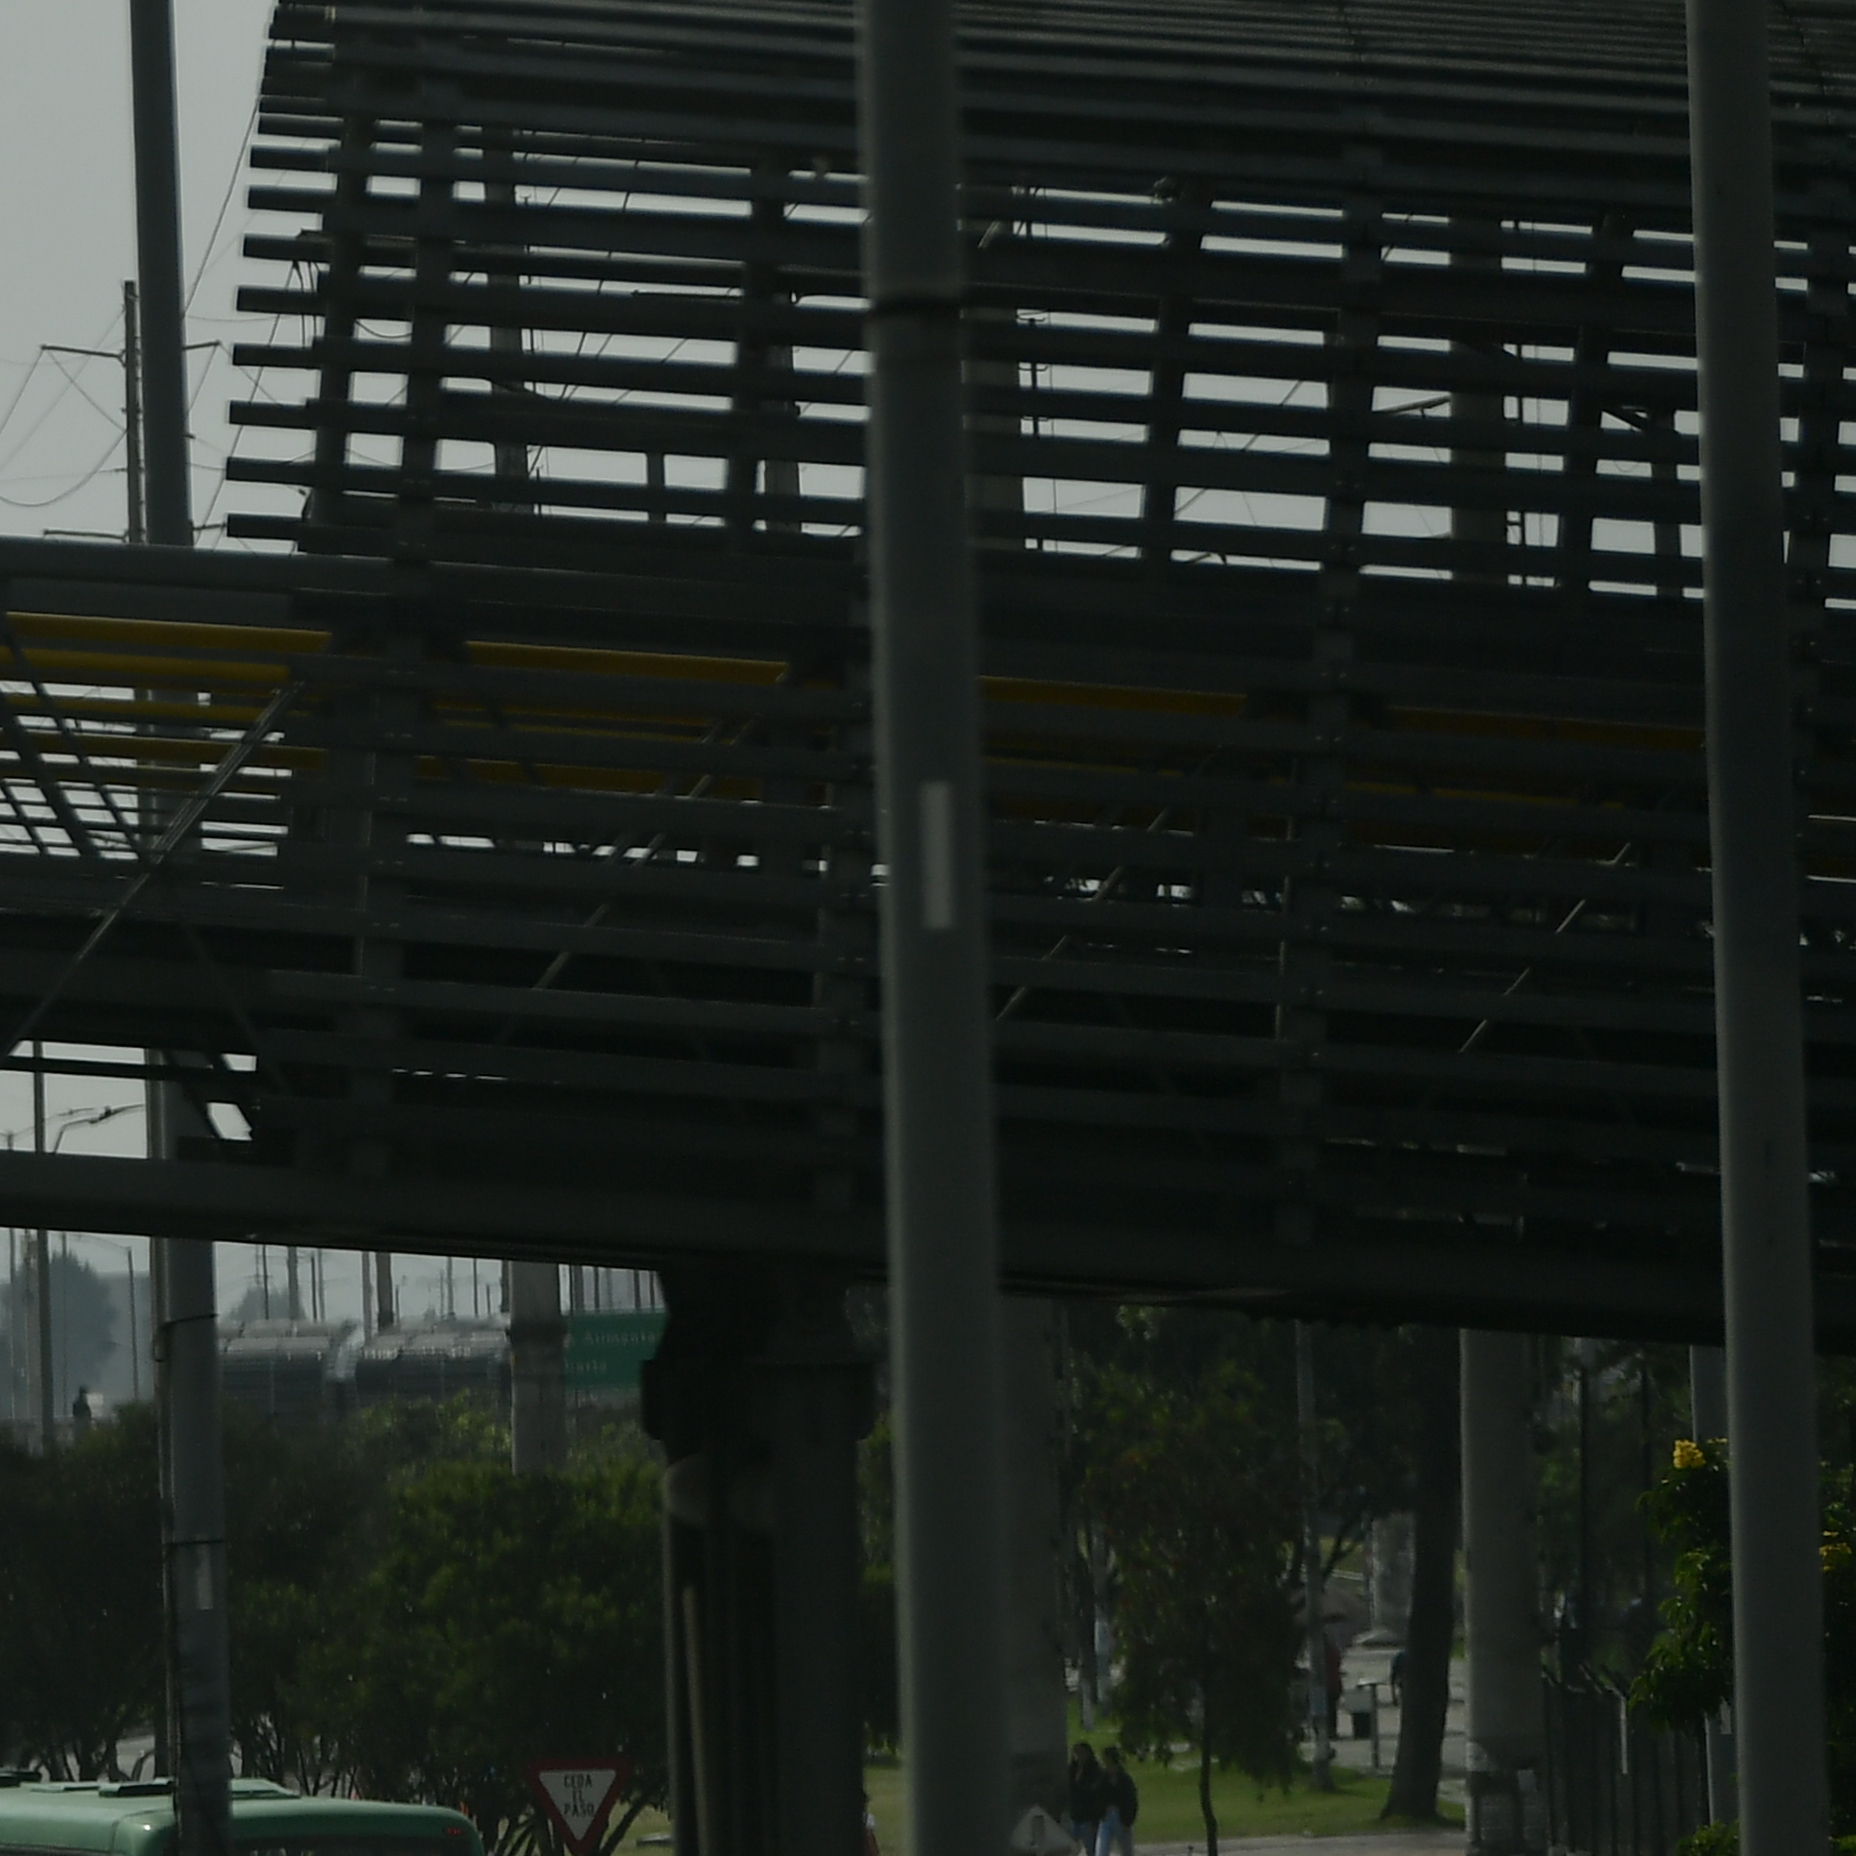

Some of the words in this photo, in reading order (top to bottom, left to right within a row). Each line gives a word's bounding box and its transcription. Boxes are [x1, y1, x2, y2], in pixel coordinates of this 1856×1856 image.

[564, 1774, 592, 1789] CEDA
[573, 1790, 585, 1804] EL
[564, 1804, 595, 1818] PASO
